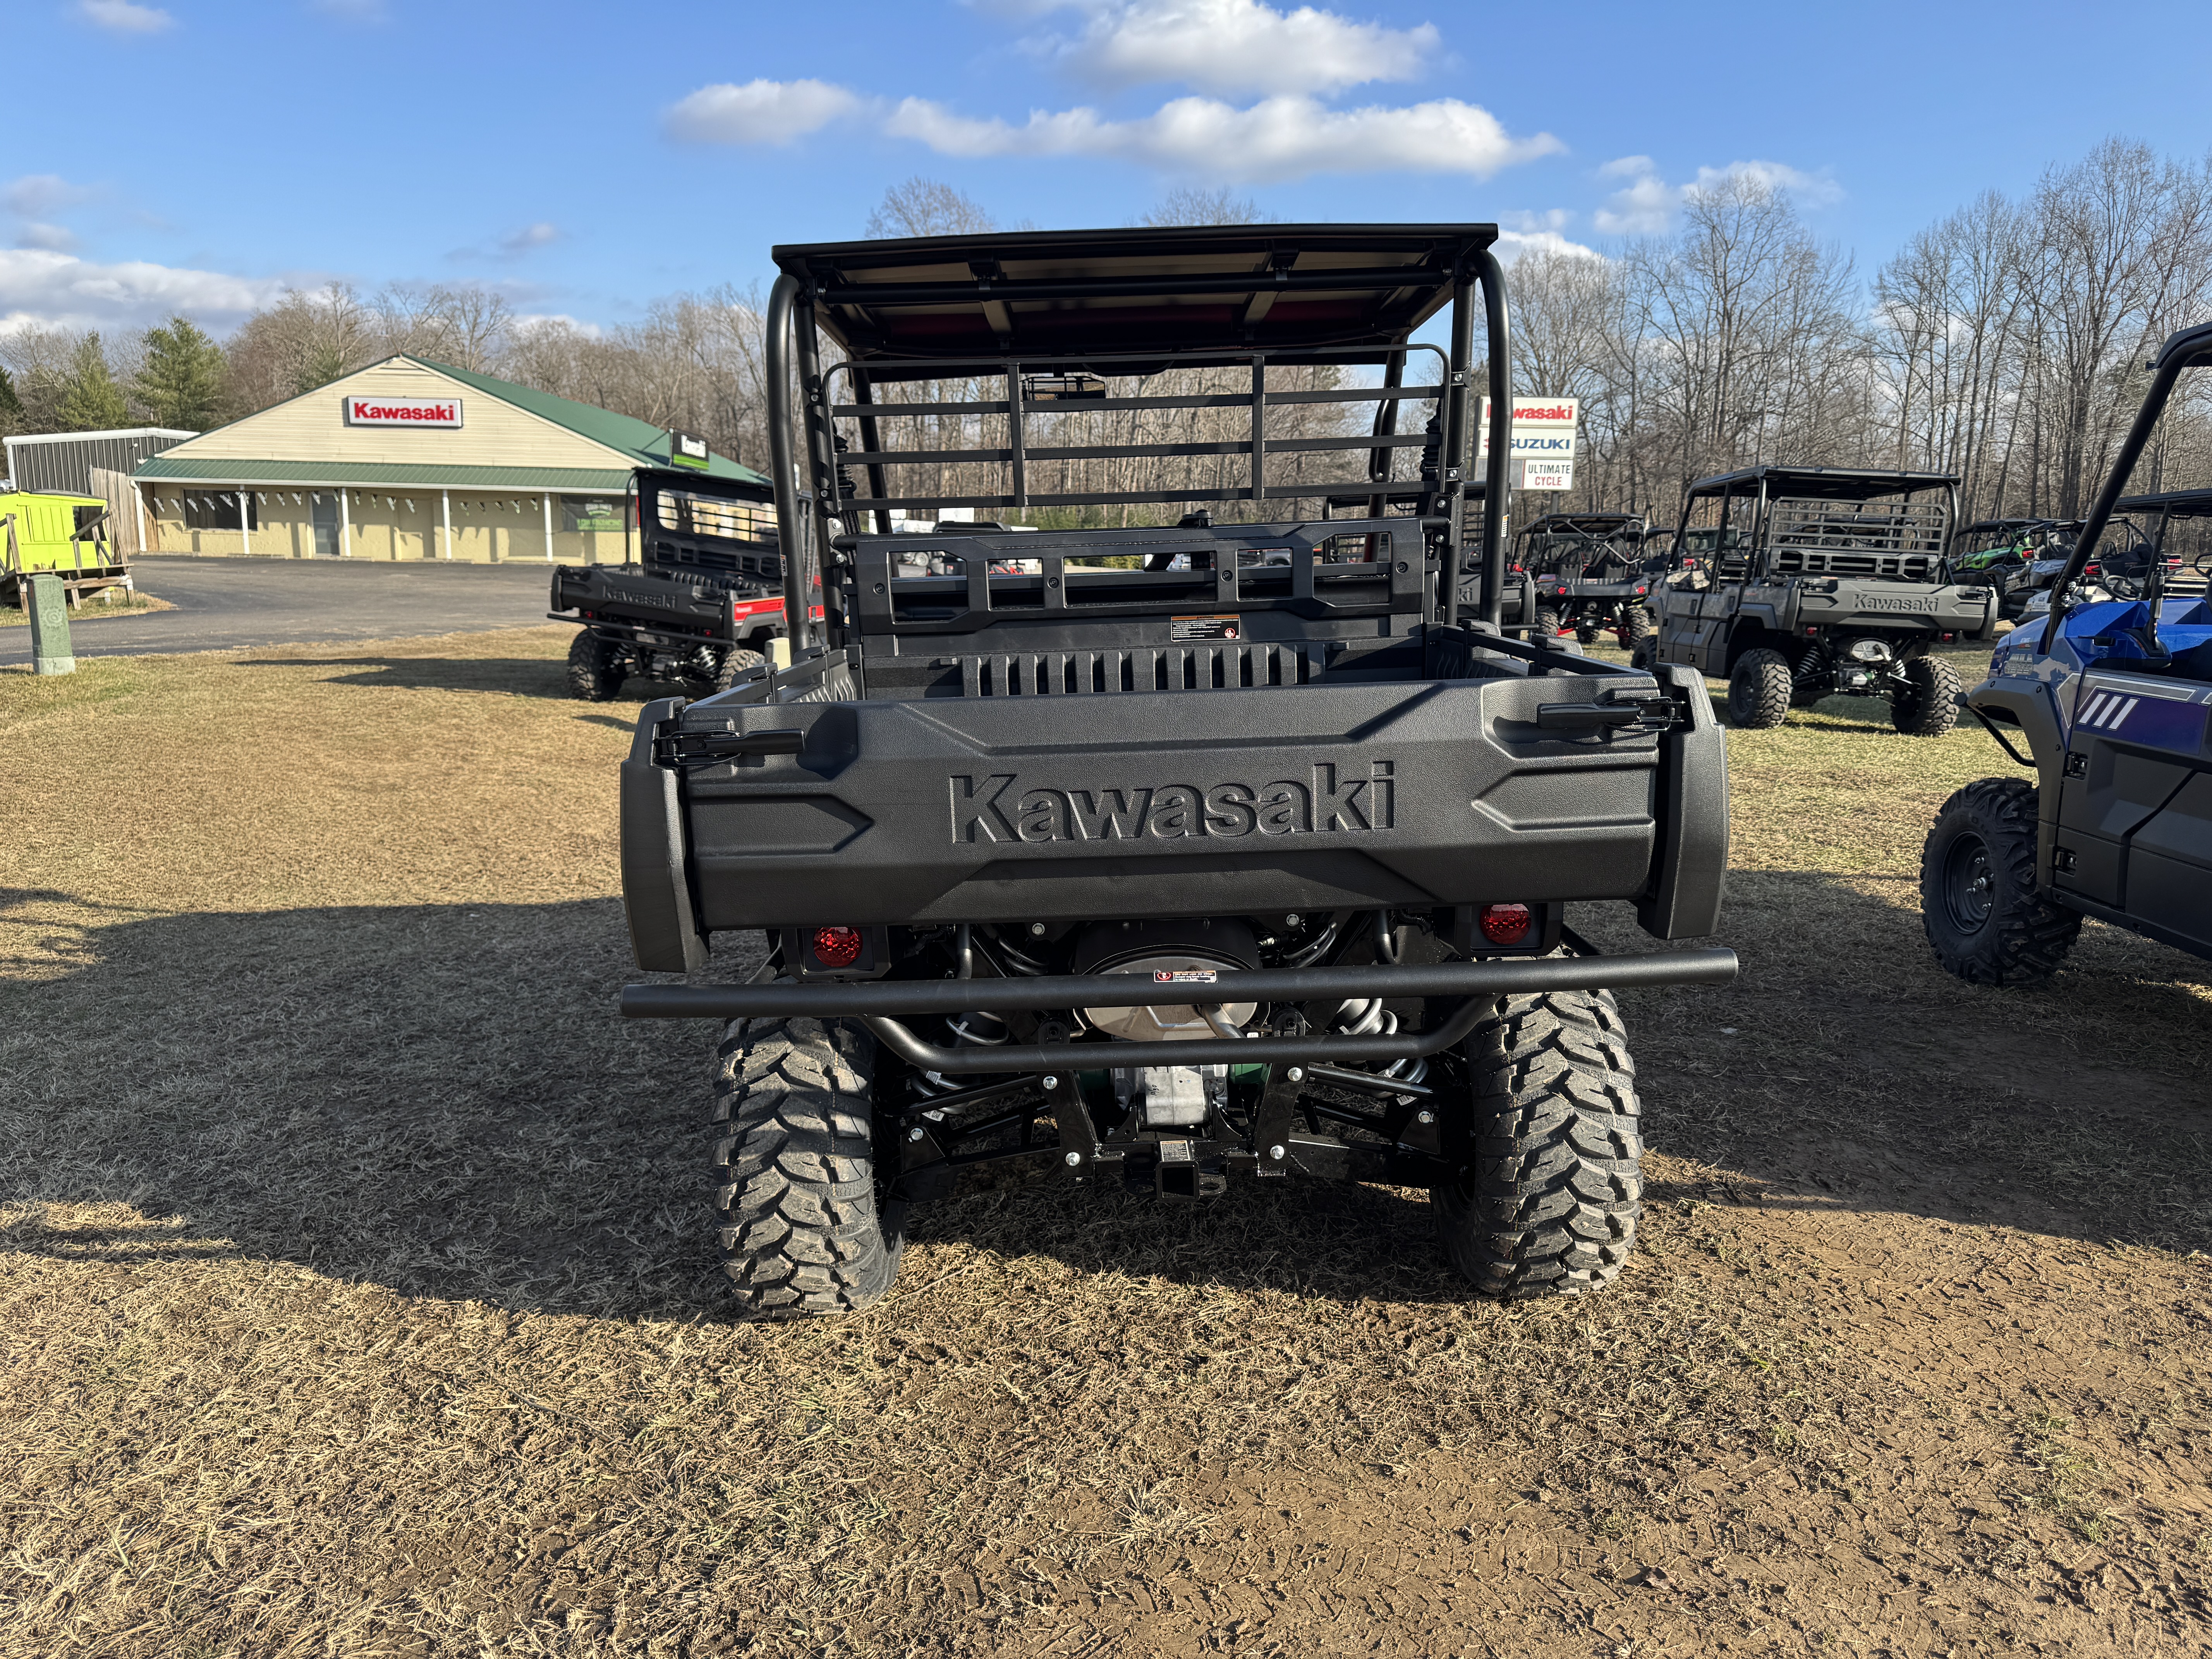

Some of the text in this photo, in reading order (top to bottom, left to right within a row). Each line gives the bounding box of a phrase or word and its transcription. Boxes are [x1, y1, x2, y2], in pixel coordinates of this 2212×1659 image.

[354, 402, 455, 421] Kawasaki
[1486, 404, 1573, 420] wasaki
[1528, 464, 1570, 474] ULTIMATE
[1535, 476, 1562, 486] CYCLE
[603, 585, 678, 608] Kawasaki
[1853, 594, 1939, 612] Kawasaki
[949, 760, 1395, 844] Kawasaki
